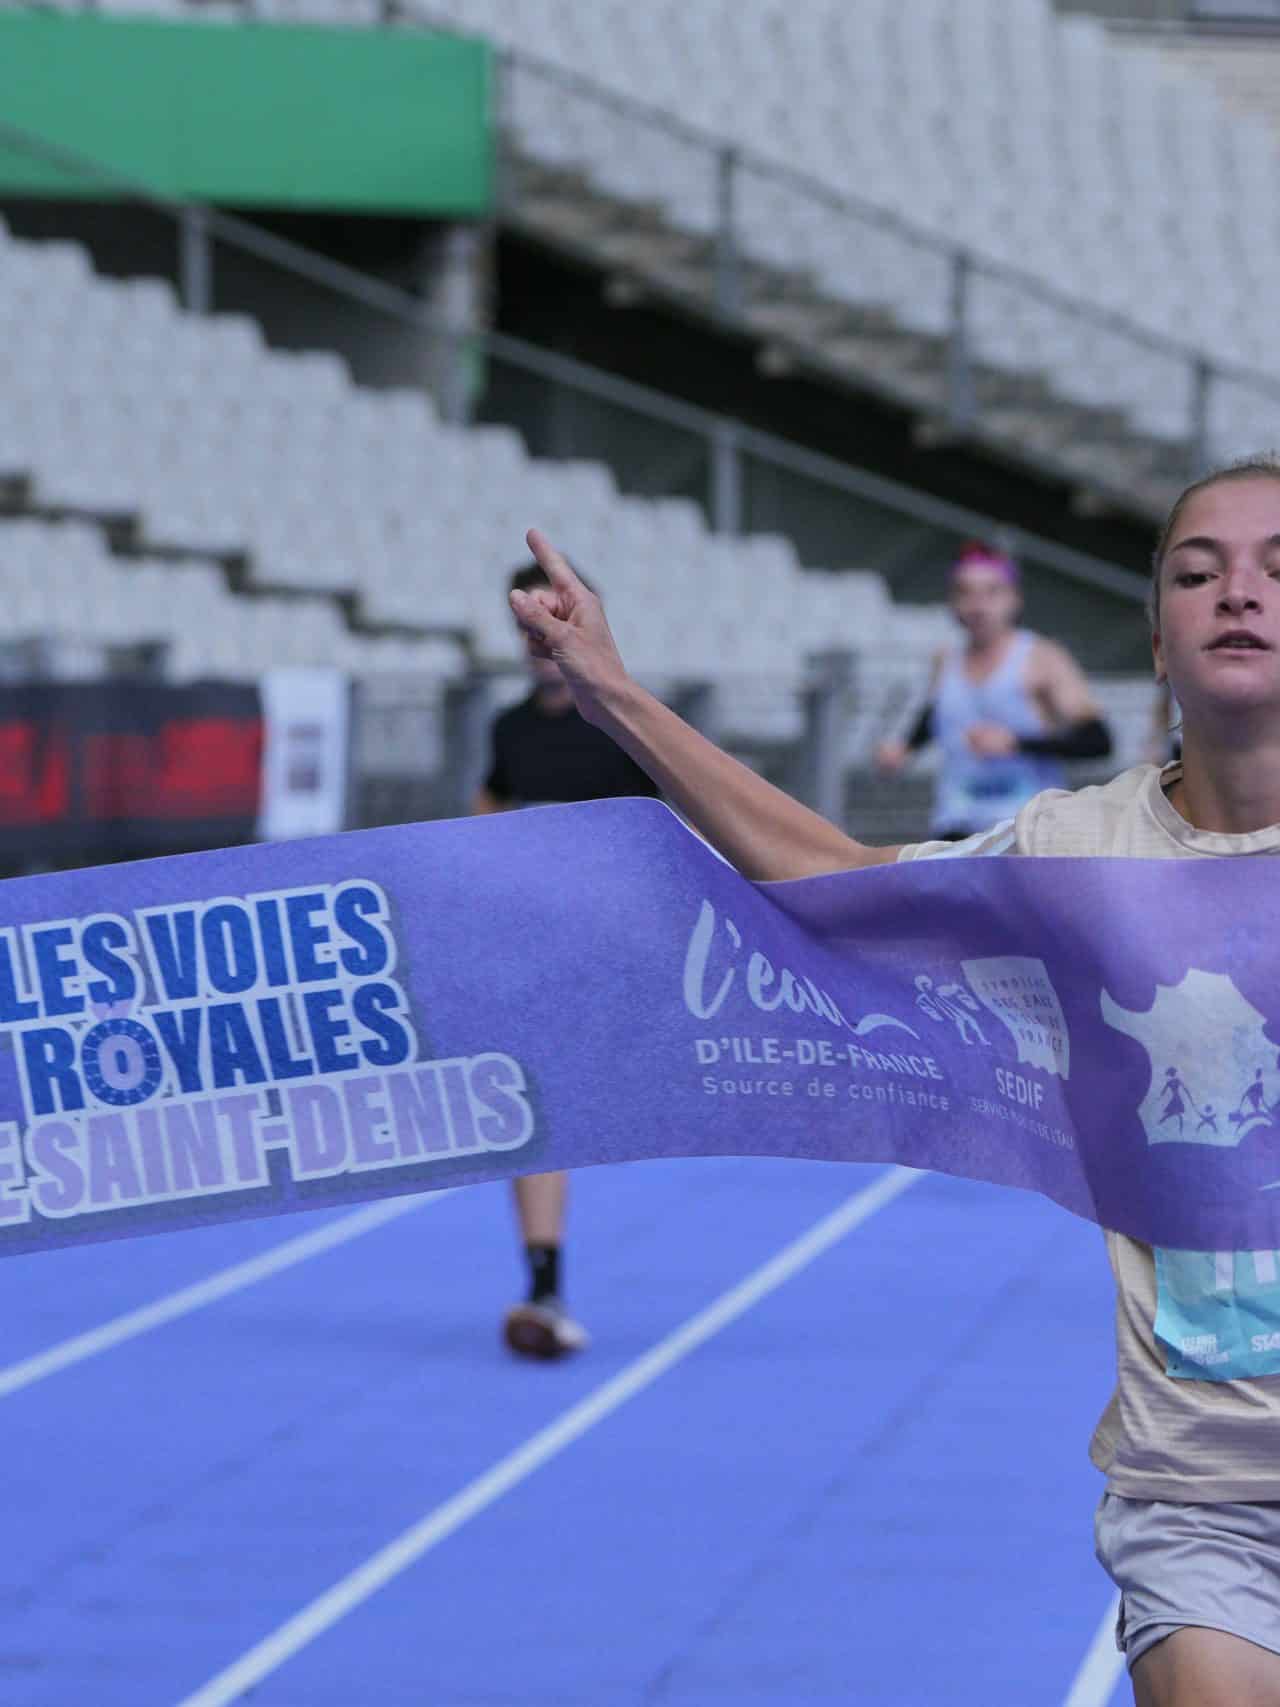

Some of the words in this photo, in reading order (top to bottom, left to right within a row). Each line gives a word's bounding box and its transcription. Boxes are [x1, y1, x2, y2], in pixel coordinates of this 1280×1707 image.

[0, 920, 137, 1022] LES
[145, 886, 389, 999] VOIES
[20, 983, 409, 1116] ROYALES
[702, 1076, 793, 1097] Source
[807, 1076, 837, 1098] de
[848, 1081, 950, 1112] confiance
[995, 1066, 1044, 1110] SEDIF
[32, 1061, 527, 1211] SAINT-DENIS
